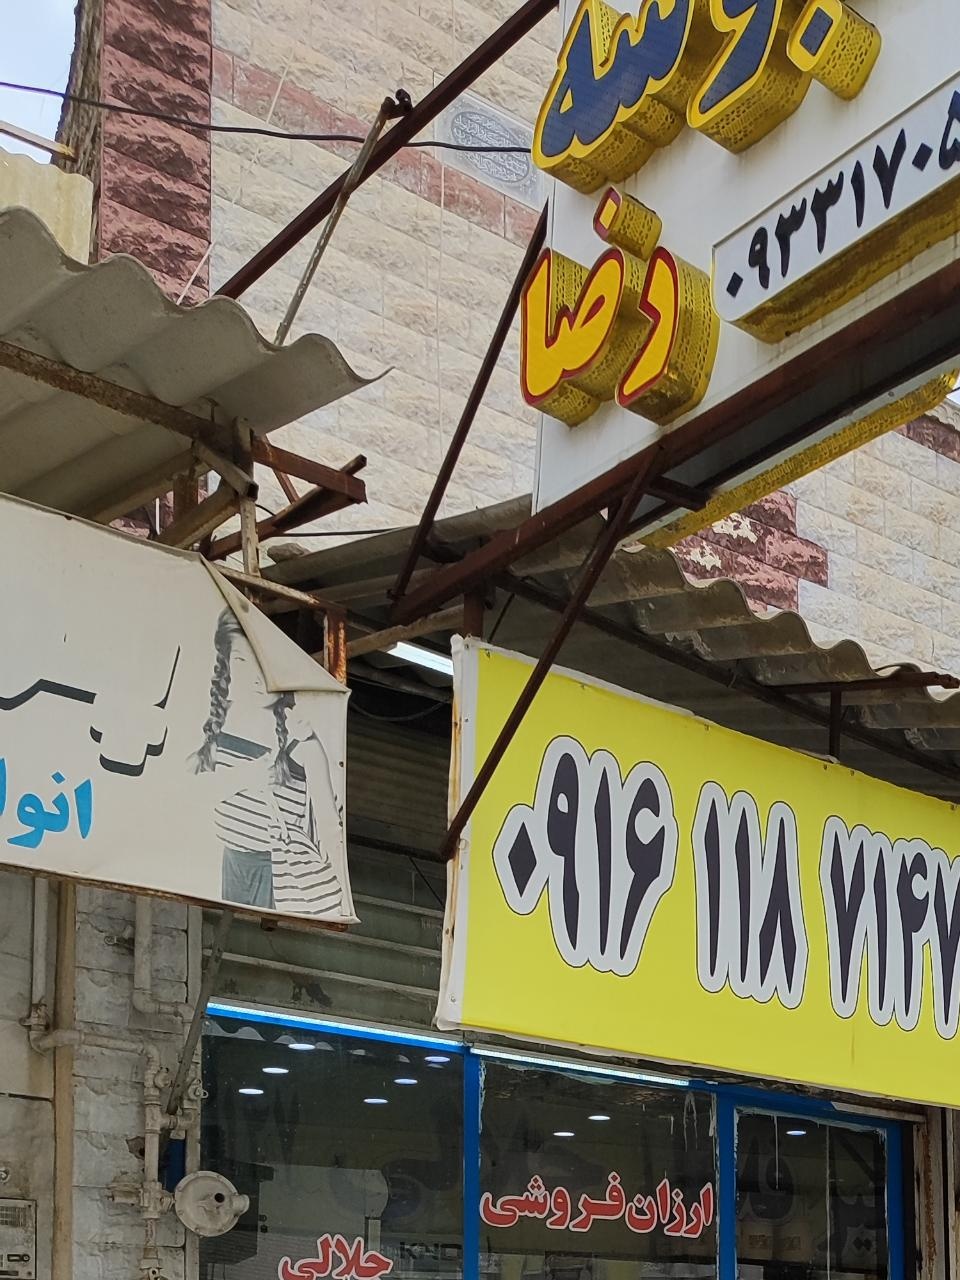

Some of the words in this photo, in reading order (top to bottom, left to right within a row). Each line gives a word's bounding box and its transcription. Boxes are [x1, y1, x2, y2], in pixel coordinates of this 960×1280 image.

[522, 186, 680, 408] رضا
[495, 738, 676, 973] ۰۹۱۶
[694, 784, 806, 1007] ۱۱۸
